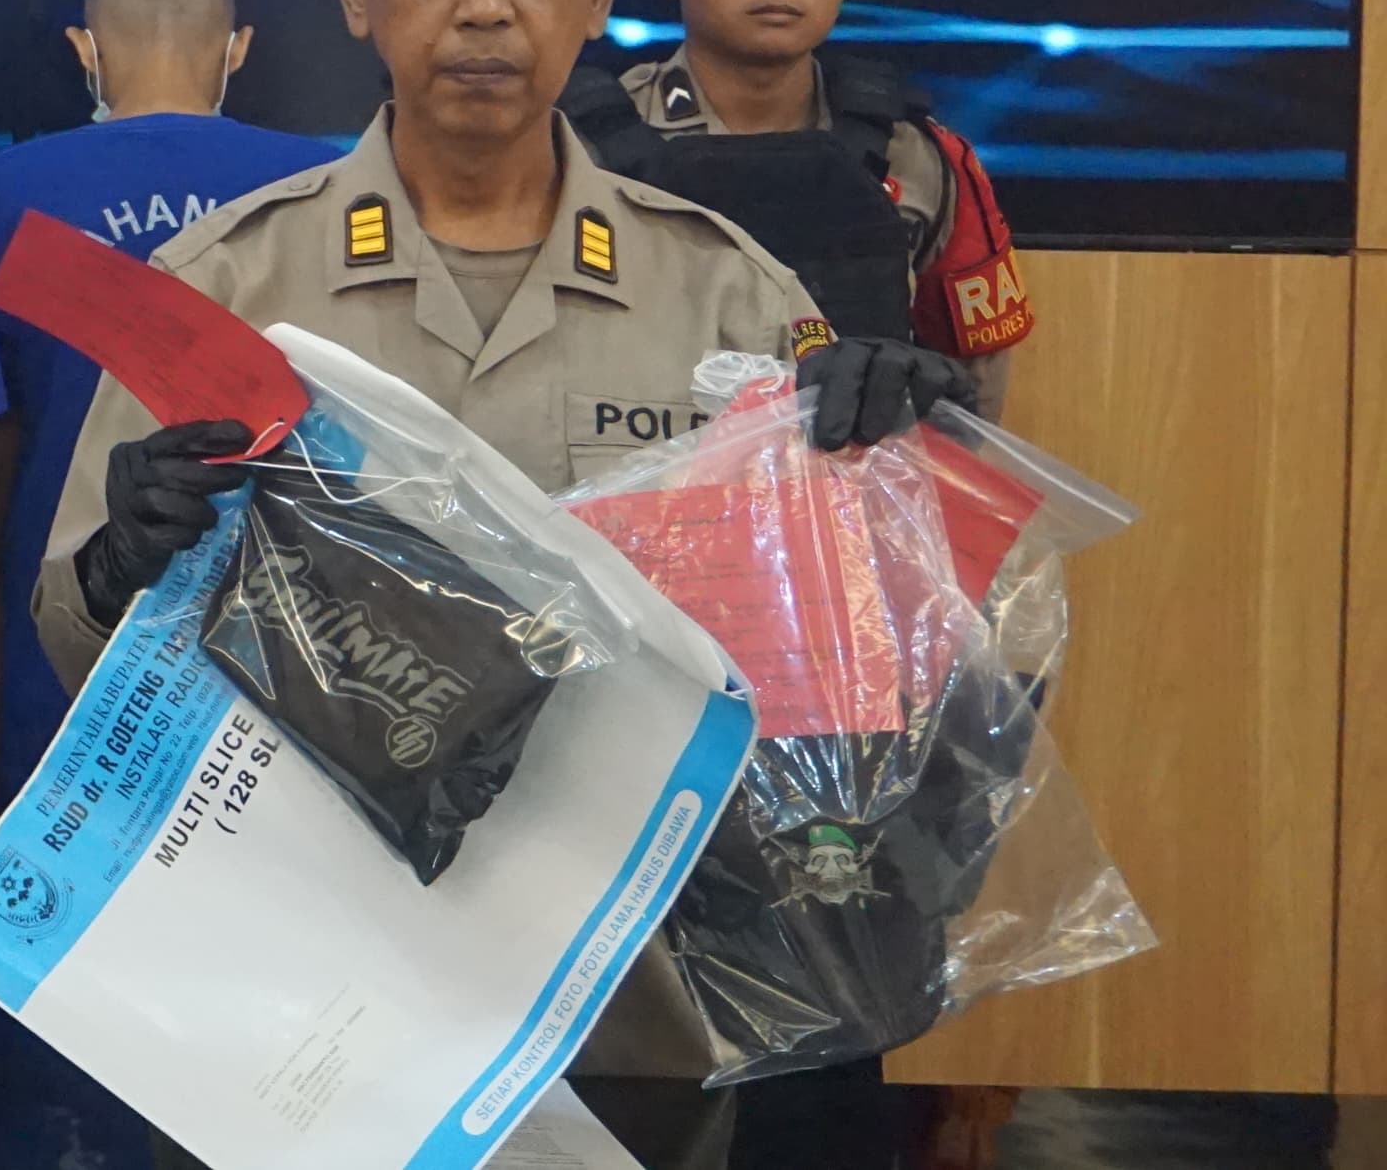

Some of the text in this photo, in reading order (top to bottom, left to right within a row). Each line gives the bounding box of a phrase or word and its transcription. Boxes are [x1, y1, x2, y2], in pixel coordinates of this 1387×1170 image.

[967, 309, 1025, 350] POLRES
[34, 715, 105, 819] PEMERINTAH
[91, 626, 156, 720] KABUPATEN
[102, 668, 167, 757] GOETENG
[76, 770, 109, 804] dr.
[93, 752, 119, 774] R
[112, 709, 175, 800] INSTALASI
[152, 712, 255, 869] MULTI SLICE
[41, 796, 91, 855] RSUD
[219, 767, 260, 818] 128
[476, 1076, 513, 1121] SETIAP
[514, 1020, 562, 1082] KONTROL
[578, 940, 610, 981] FOTO
[606, 903, 636, 943] LAMA
[630, 856, 665, 901] HARUS
[657, 804, 693, 857] DIBAWA
